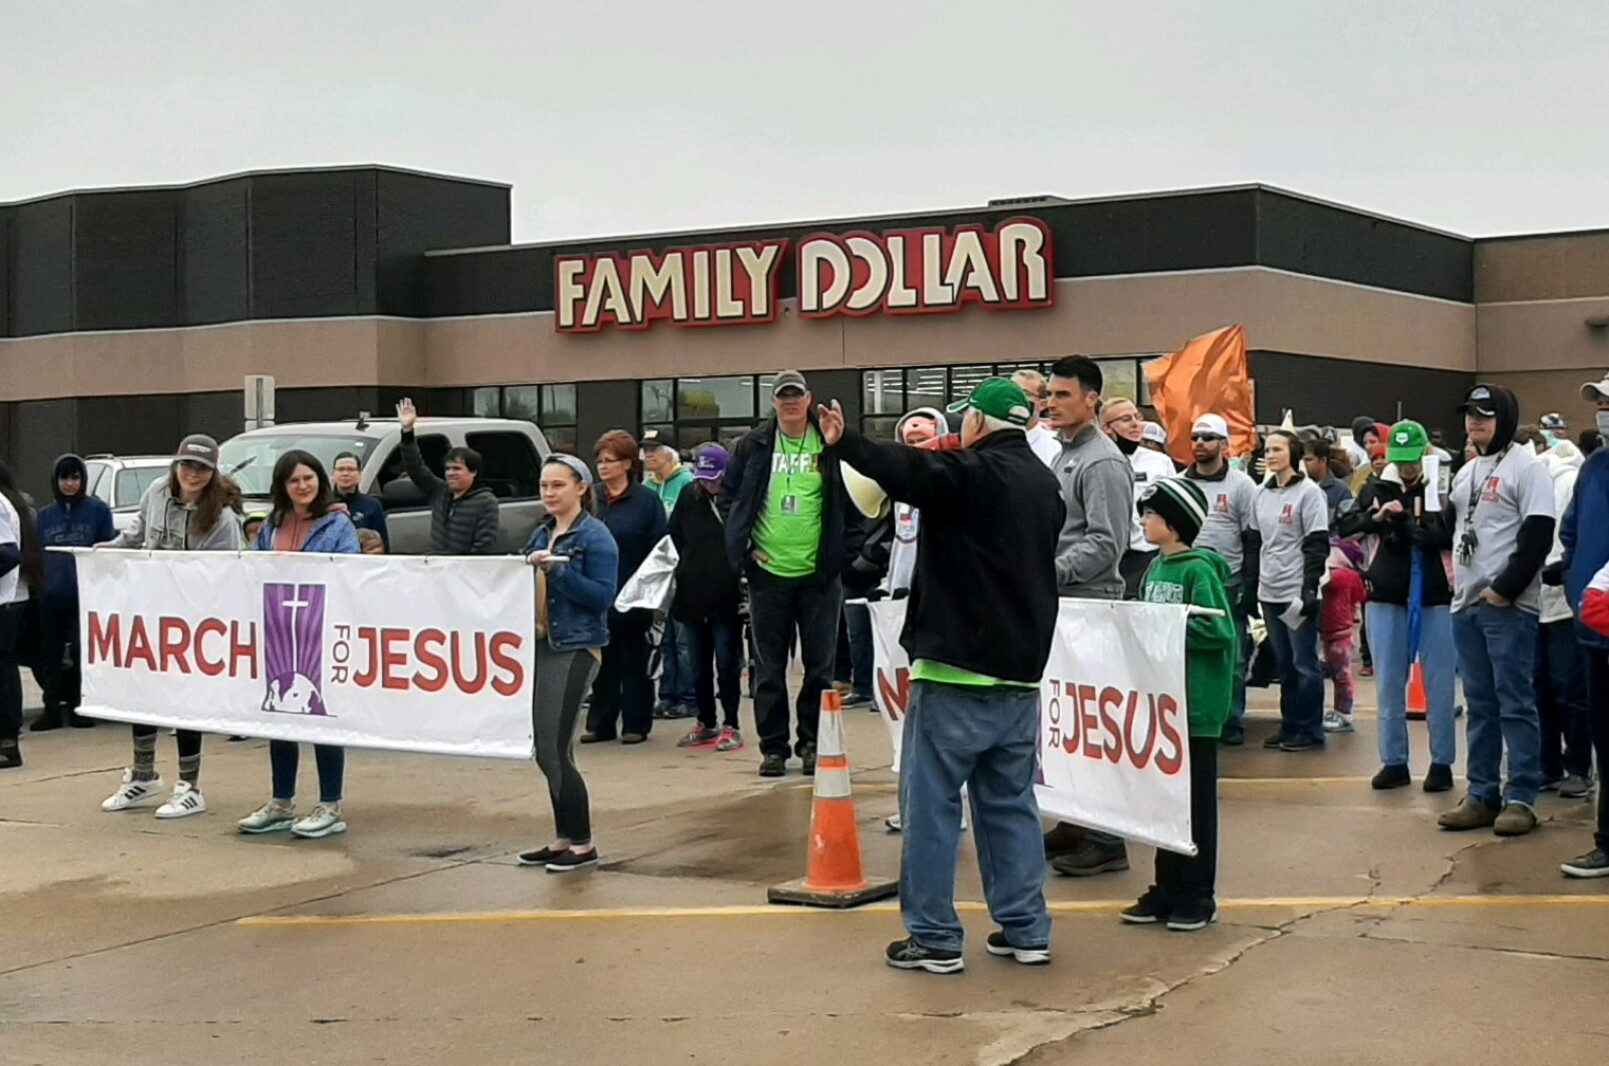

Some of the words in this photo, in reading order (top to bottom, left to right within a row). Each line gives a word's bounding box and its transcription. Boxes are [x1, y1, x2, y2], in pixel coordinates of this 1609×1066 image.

[558, 245, 779, 327] FAMILY
[801, 222, 1047, 311] DOLLAR
[771, 452, 811, 474] TAFF
[88, 611, 258, 679] MARCH
[331, 624, 351, 684] FOR
[352, 626, 524, 696] JESUS
[1048, 679, 1060, 748] FOR
[1062, 682, 1183, 776] JESUS
